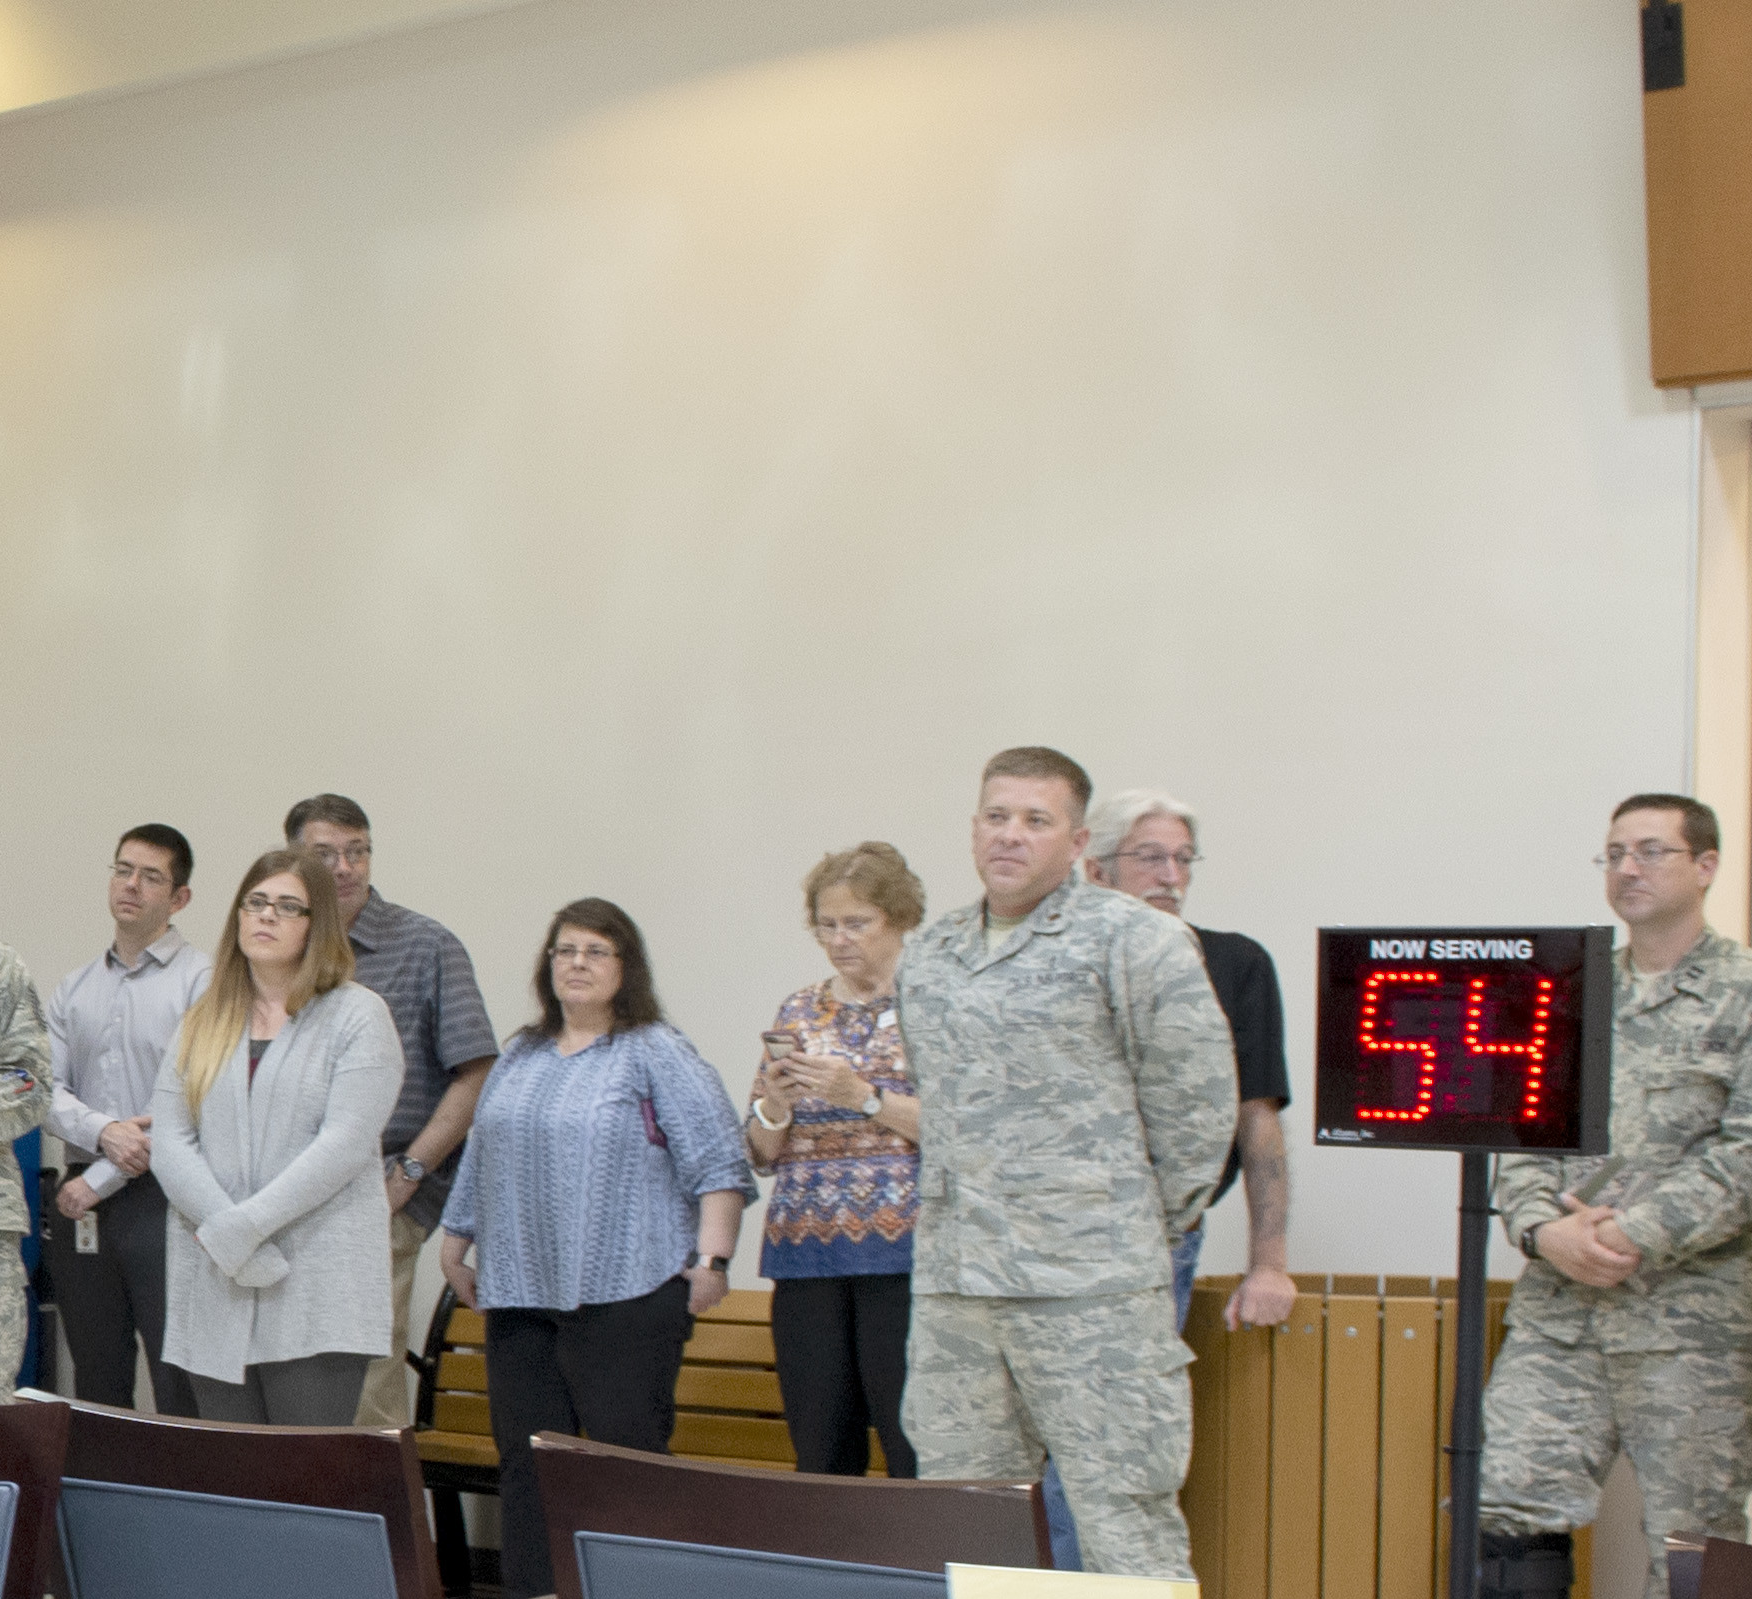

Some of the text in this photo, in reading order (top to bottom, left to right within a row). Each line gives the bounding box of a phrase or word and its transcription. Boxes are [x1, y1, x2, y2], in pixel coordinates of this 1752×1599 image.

[1369, 939, 1534, 961] NOW SERVING
[1355, 971, 1555, 1123] 54
